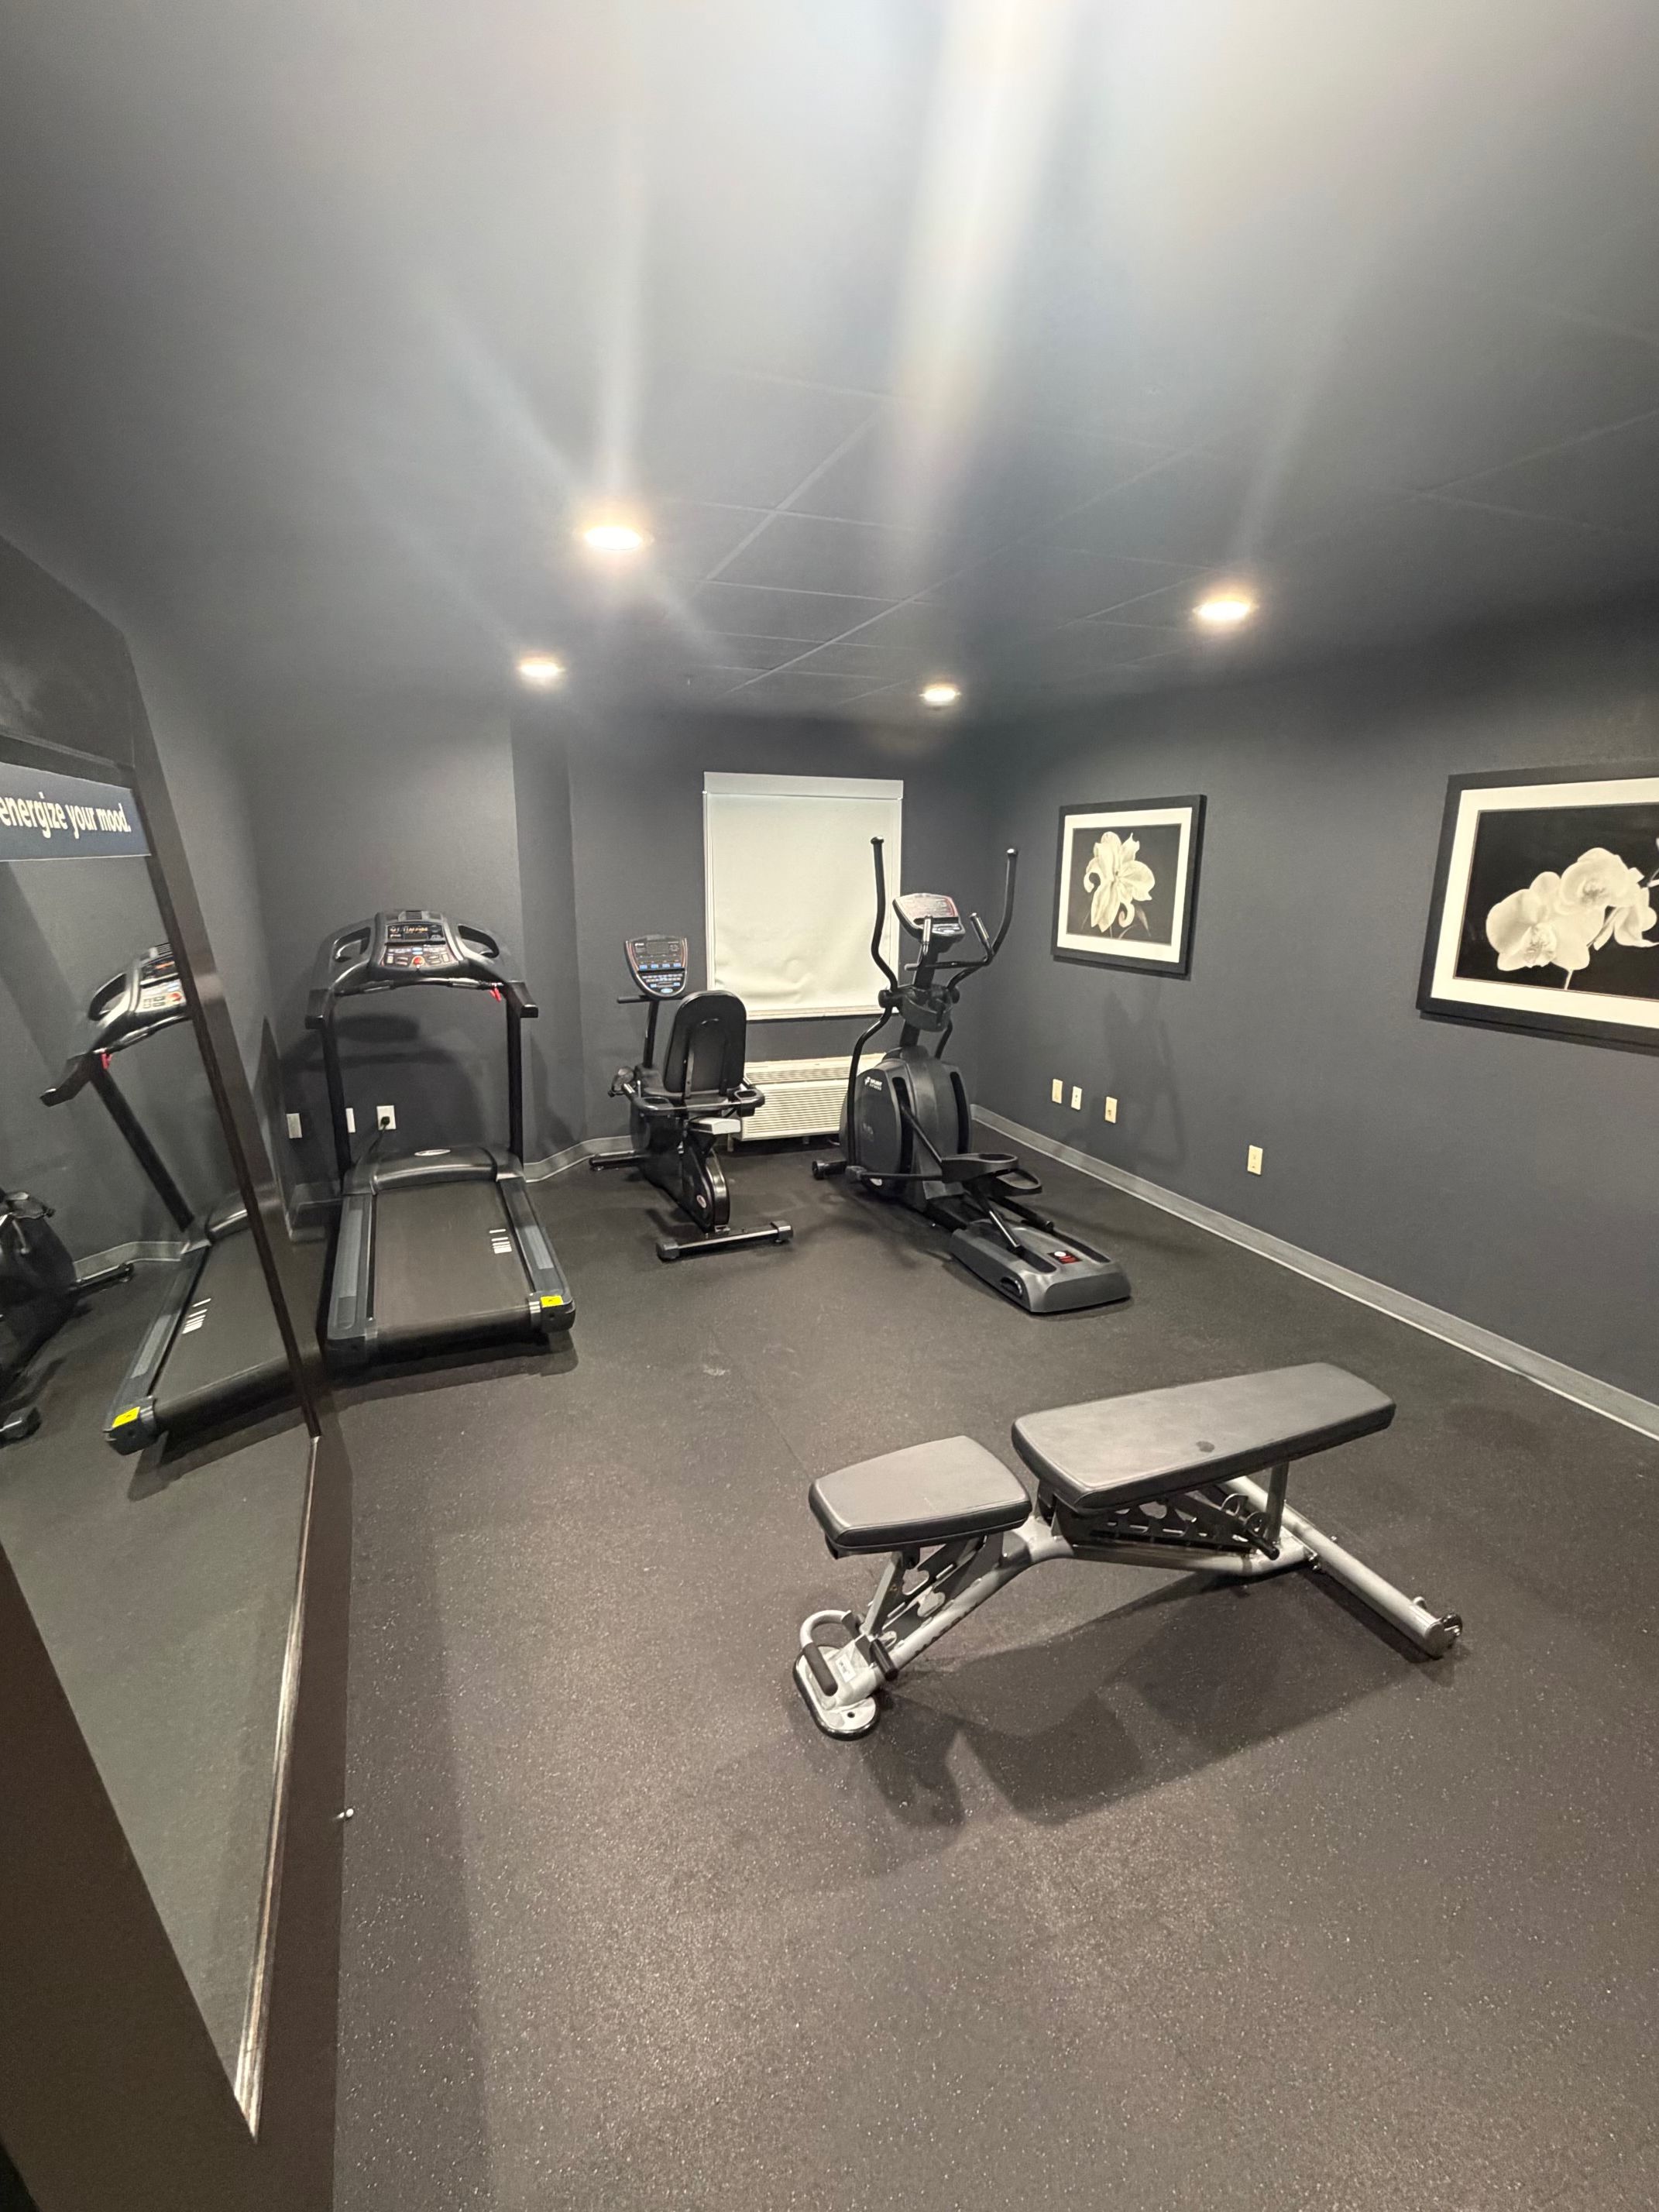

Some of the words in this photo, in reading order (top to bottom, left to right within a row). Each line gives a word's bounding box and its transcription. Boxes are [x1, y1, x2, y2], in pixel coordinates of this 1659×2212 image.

[0, 792, 67, 839] energize
[65, 804, 98, 839] your
[95, 802, 132, 833] mood.
